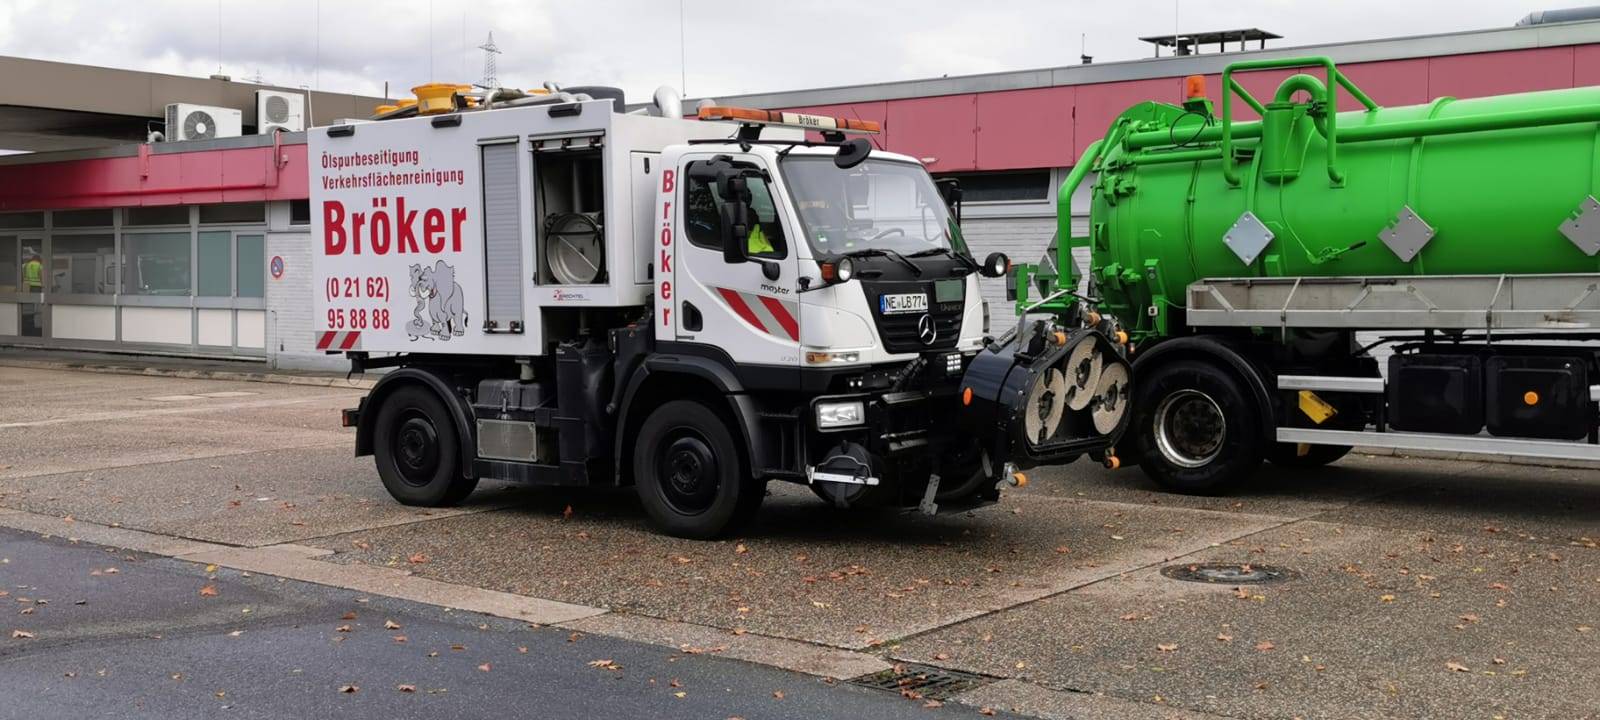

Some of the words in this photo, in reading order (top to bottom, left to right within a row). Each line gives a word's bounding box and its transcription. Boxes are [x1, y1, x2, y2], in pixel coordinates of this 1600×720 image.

[798, 115, 819, 126] Bröker
[322, 149, 419, 170] Ölspurbeseitigung
[322, 169, 464, 189] Verkehrsflächenreinigung
[323, 196, 467, 255] Bröker
[660, 169, 674, 326] Bröker
[326, 277, 339, 302] (0
[344, 277, 360, 298] 21
[366, 276, 389, 302] 62)
[885, 296, 896, 309] NE
[327, 308, 344, 329] 95
[350, 308, 367, 329] 88
[372, 308, 390, 329] 88
